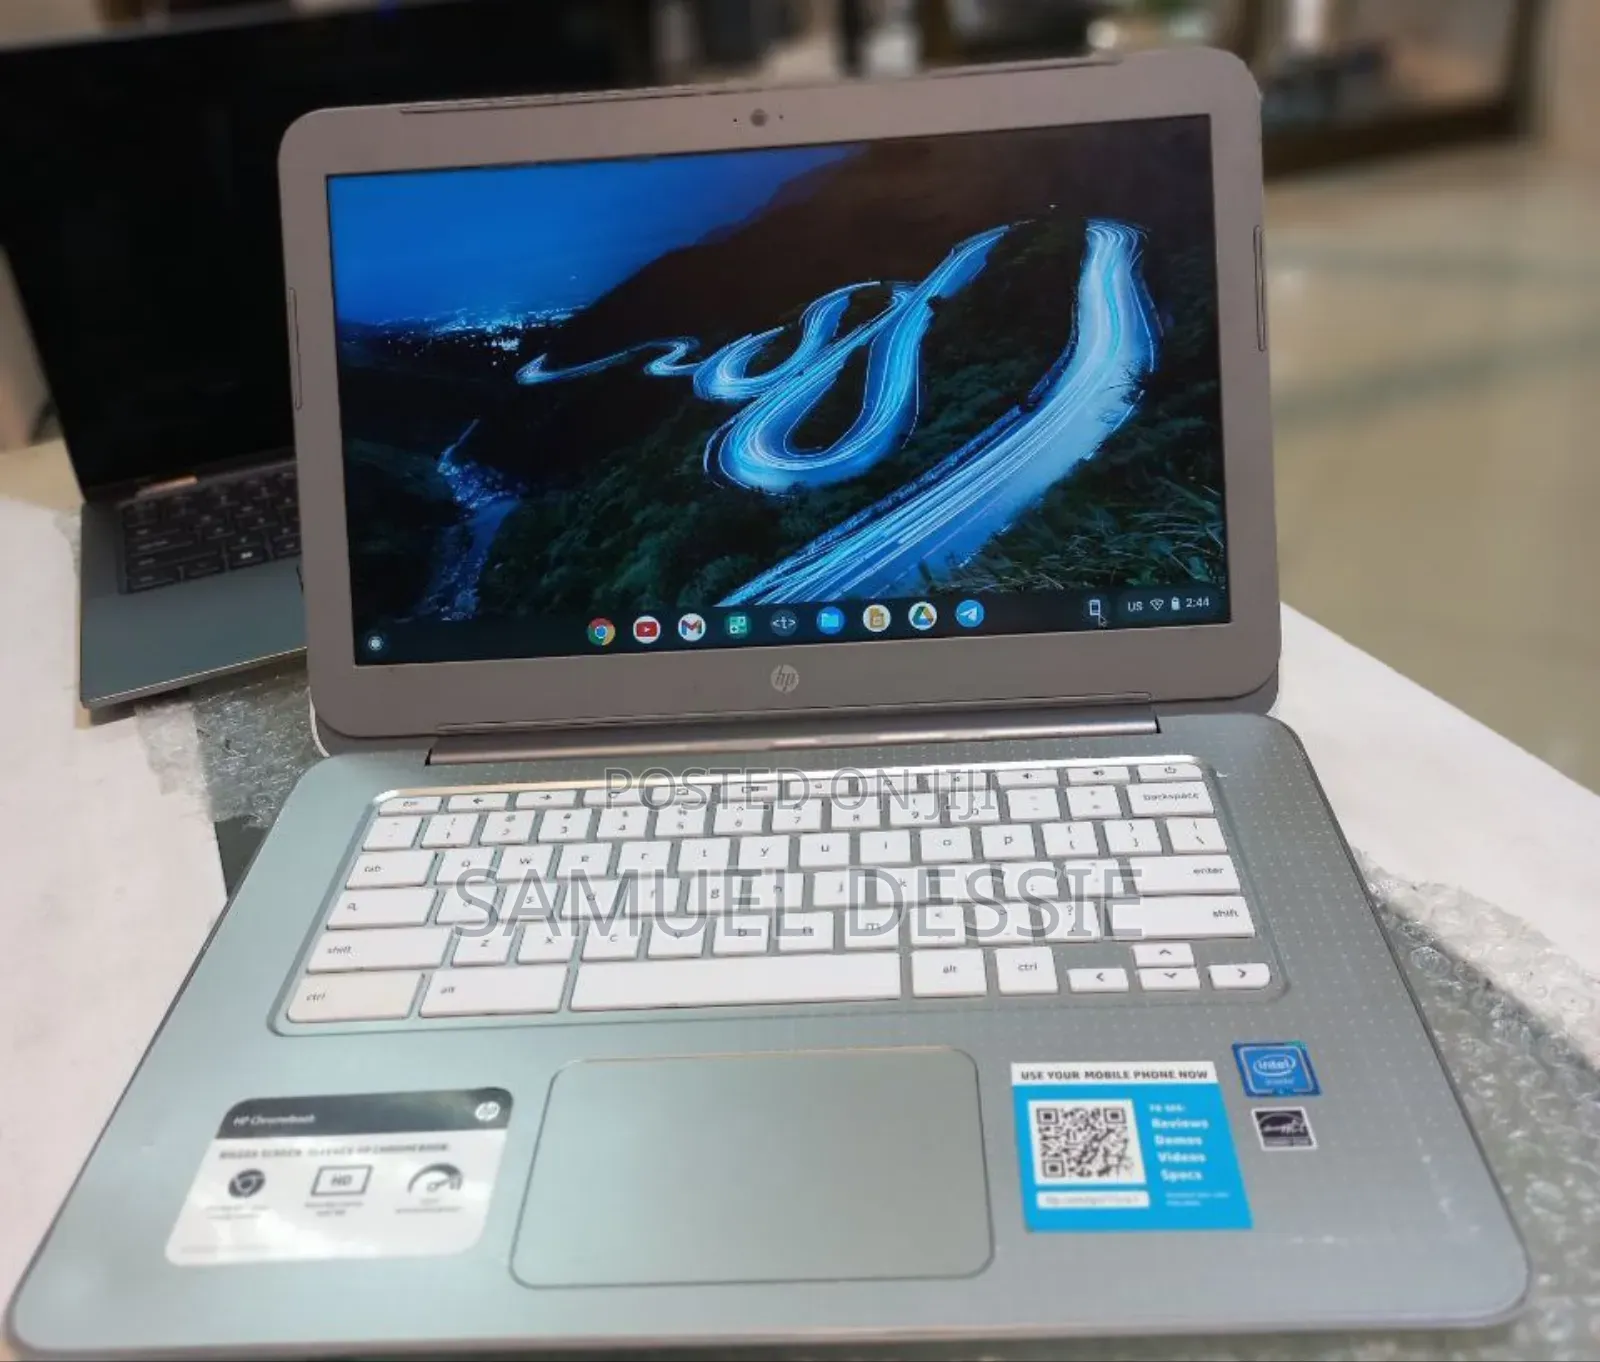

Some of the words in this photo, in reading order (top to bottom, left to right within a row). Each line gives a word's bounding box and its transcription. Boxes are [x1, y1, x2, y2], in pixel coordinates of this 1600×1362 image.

[1127, 601, 1143, 612] US
[1185, 596, 1210, 608] 2:44
[775, 664, 799, 693] hp
[1193, 866, 1224, 874] enter
[1212, 908, 1240, 918] shift
[942, 964, 958, 974] alt
[1017, 963, 1038, 972] ctrl
[1021, 1071, 1043, 1081] USE
[1048, 1071, 1080, 1081] YOUR
[1084, 1070, 1130, 1080] MOBILE
[1134, 1069, 1176, 1080] PHONE
[1179, 1069, 1208, 1079] NOW
[1151, 1117, 1209, 1130] Reviews
[1154, 1134, 1203, 1146] Demos
[1157, 1151, 1207, 1164] Videos
[1160, 1168, 1204, 1183] Specs
